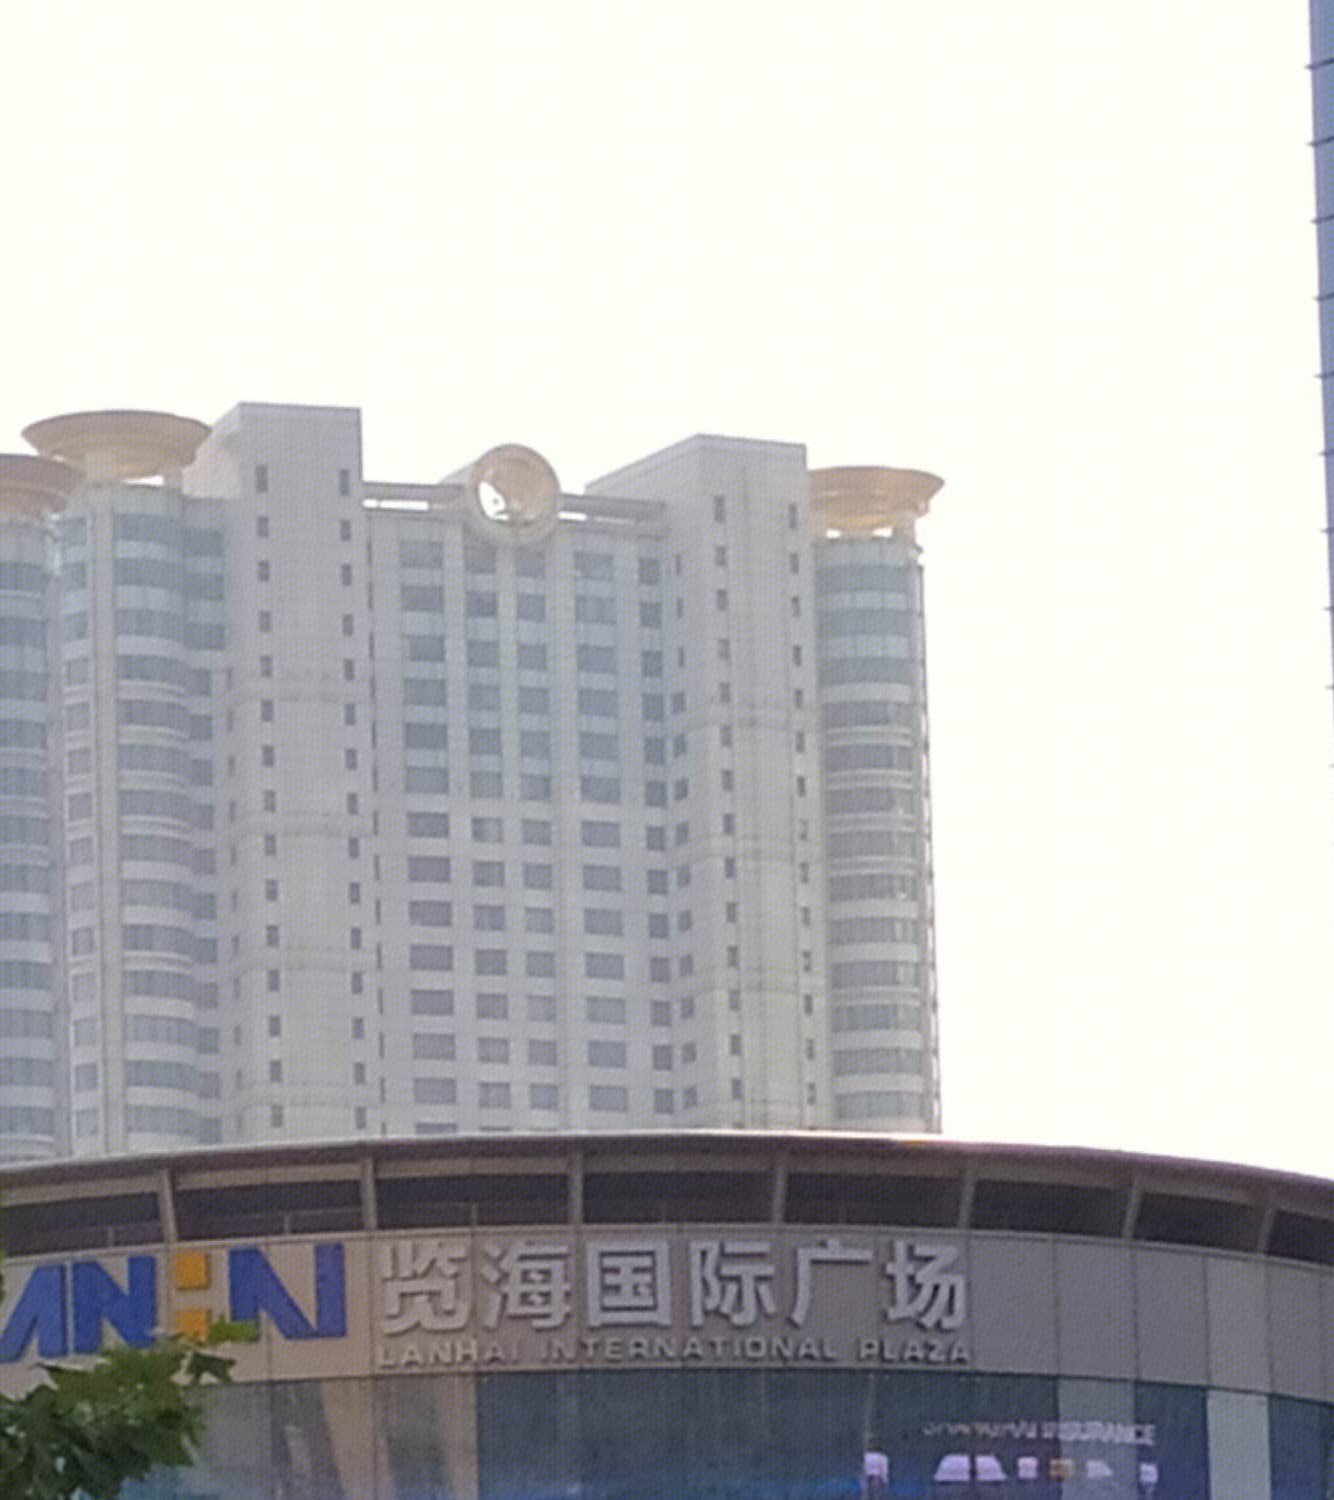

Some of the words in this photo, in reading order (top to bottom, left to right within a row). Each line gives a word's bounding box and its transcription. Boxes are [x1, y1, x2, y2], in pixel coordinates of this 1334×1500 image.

[379, 1238, 967, 1334] 览海国际广场
[378, 1339, 519, 1370] LANHAI
[542, 1336, 838, 1364] INTERNATIONAL
[858, 1337, 970, 1364] PLAZA
